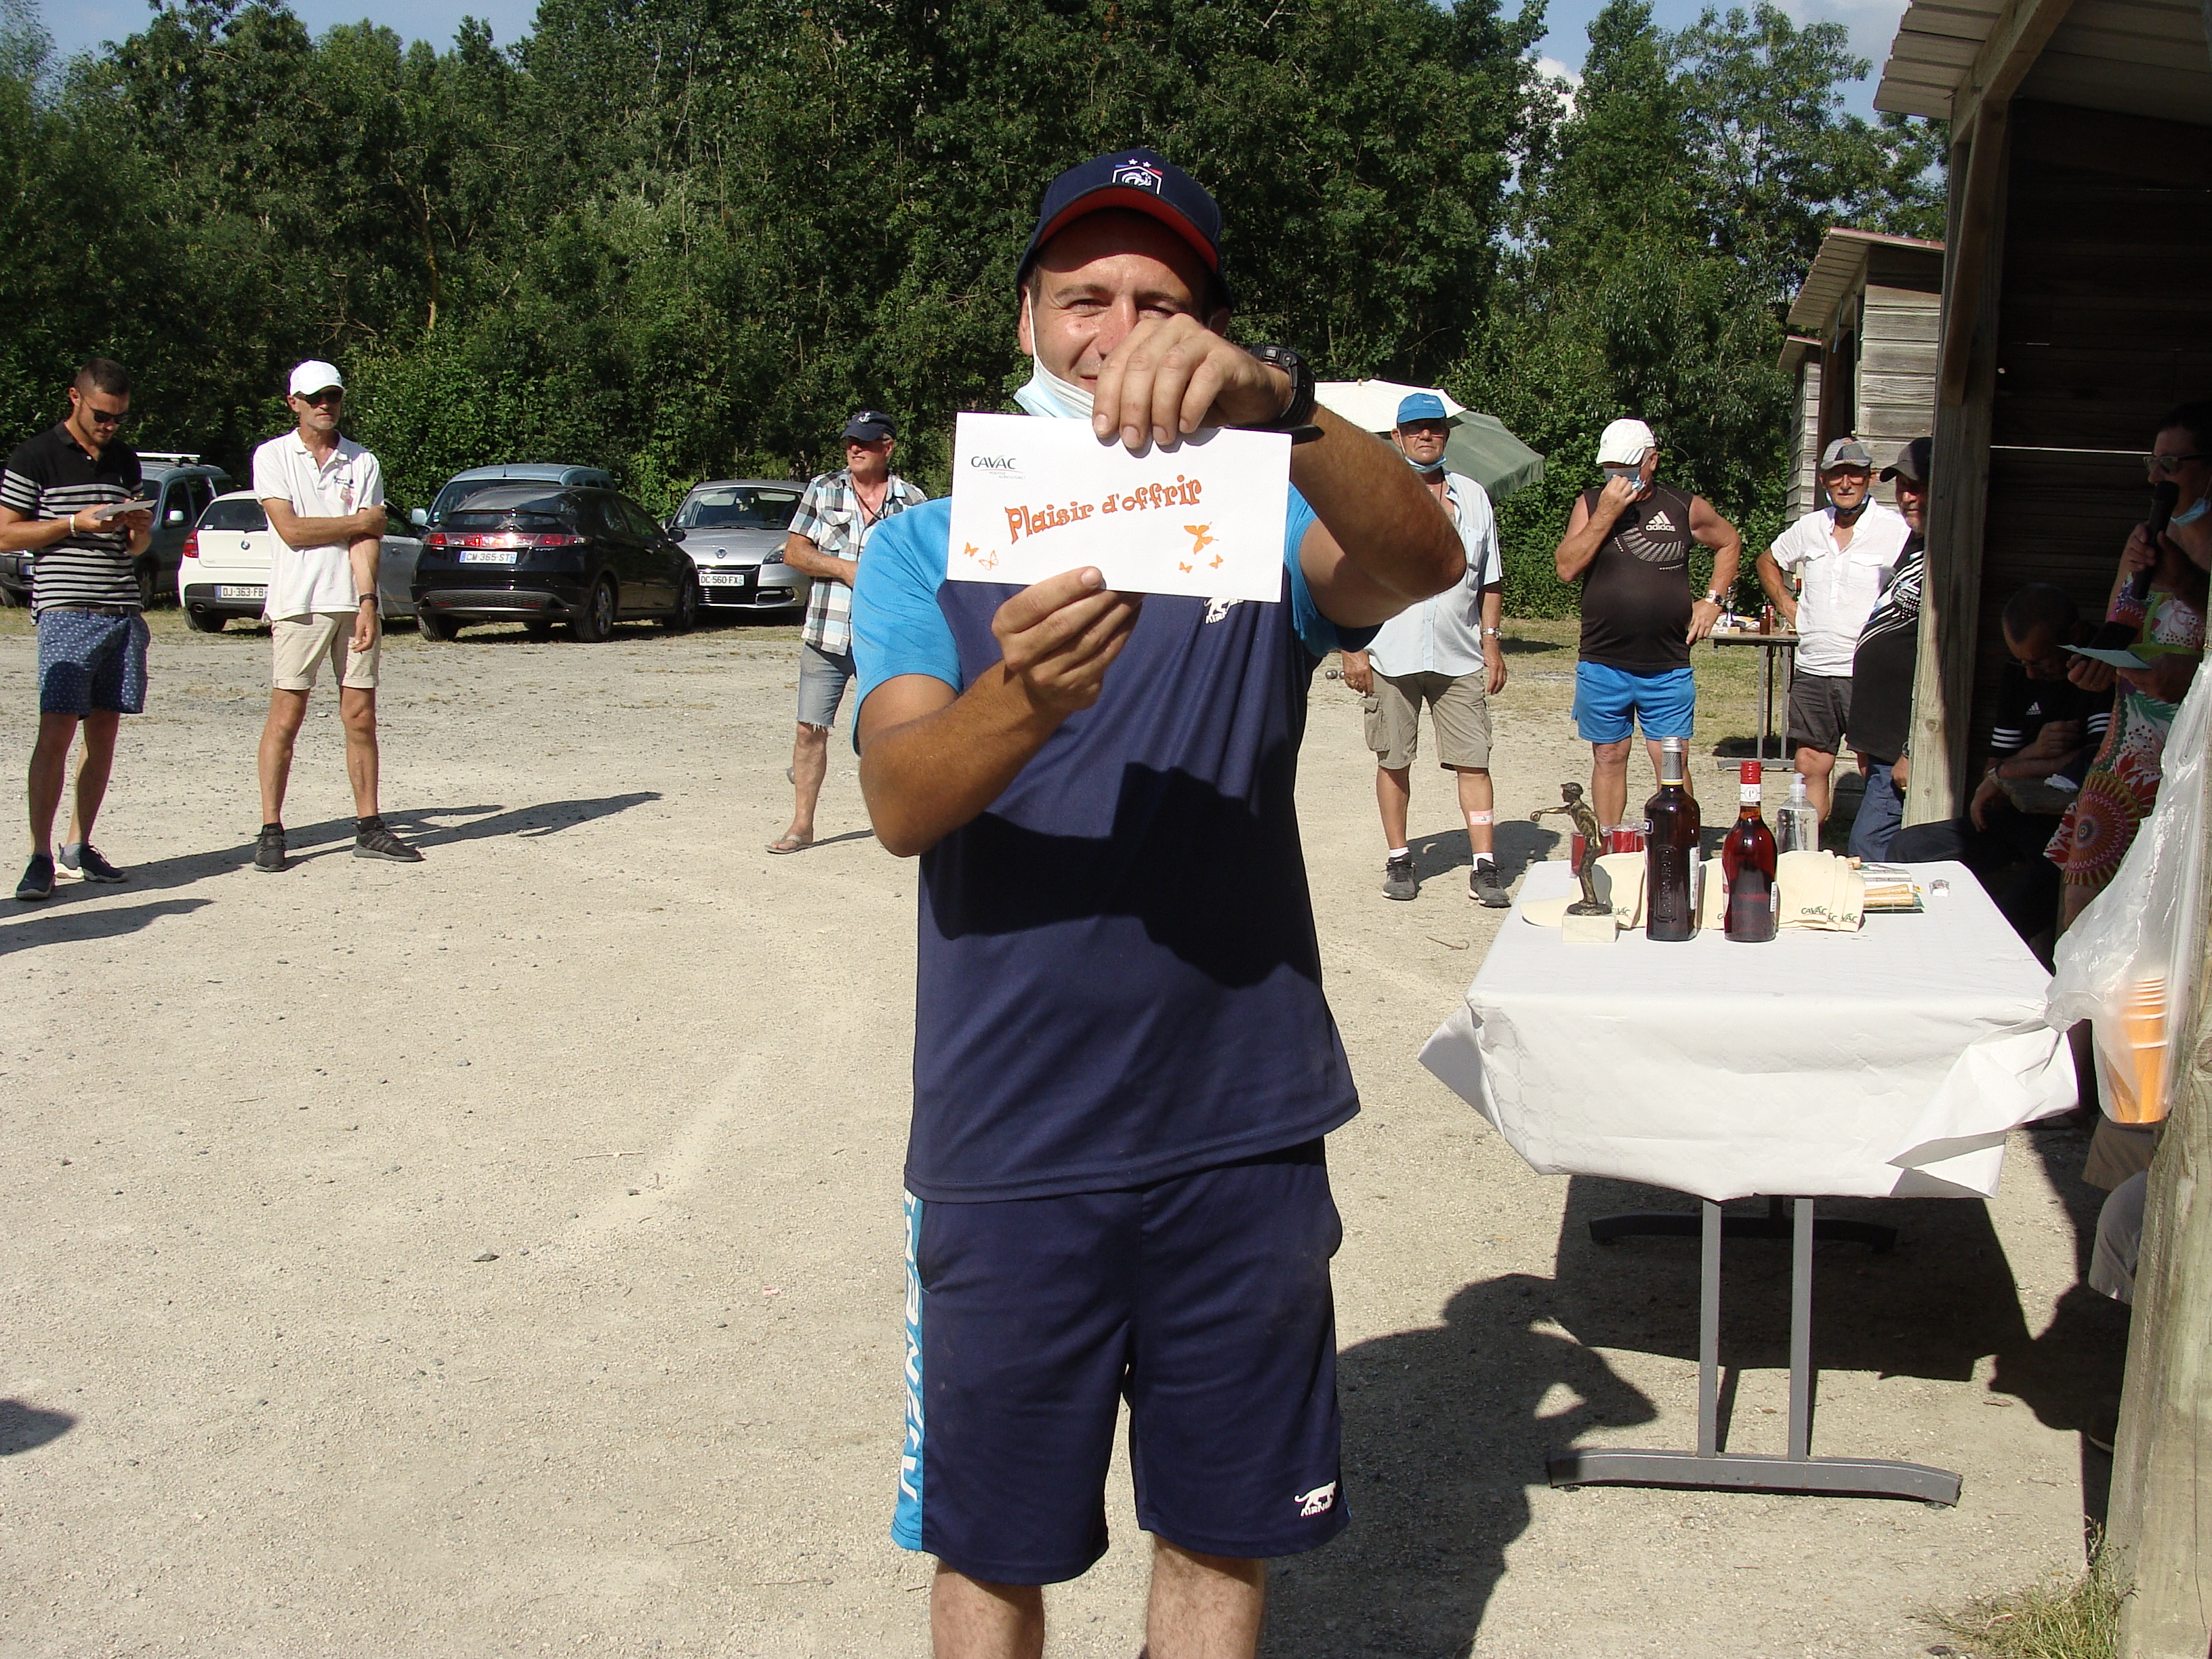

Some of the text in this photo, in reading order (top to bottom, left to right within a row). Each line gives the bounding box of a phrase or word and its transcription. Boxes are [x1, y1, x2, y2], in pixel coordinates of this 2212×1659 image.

[970, 455, 1017, 470] CAVAC
[1004, 474, 1202, 545] Plaisir d'offrir
[1645, 523, 1676, 532] adidas
[1801, 906, 1828, 915] CAVAC
